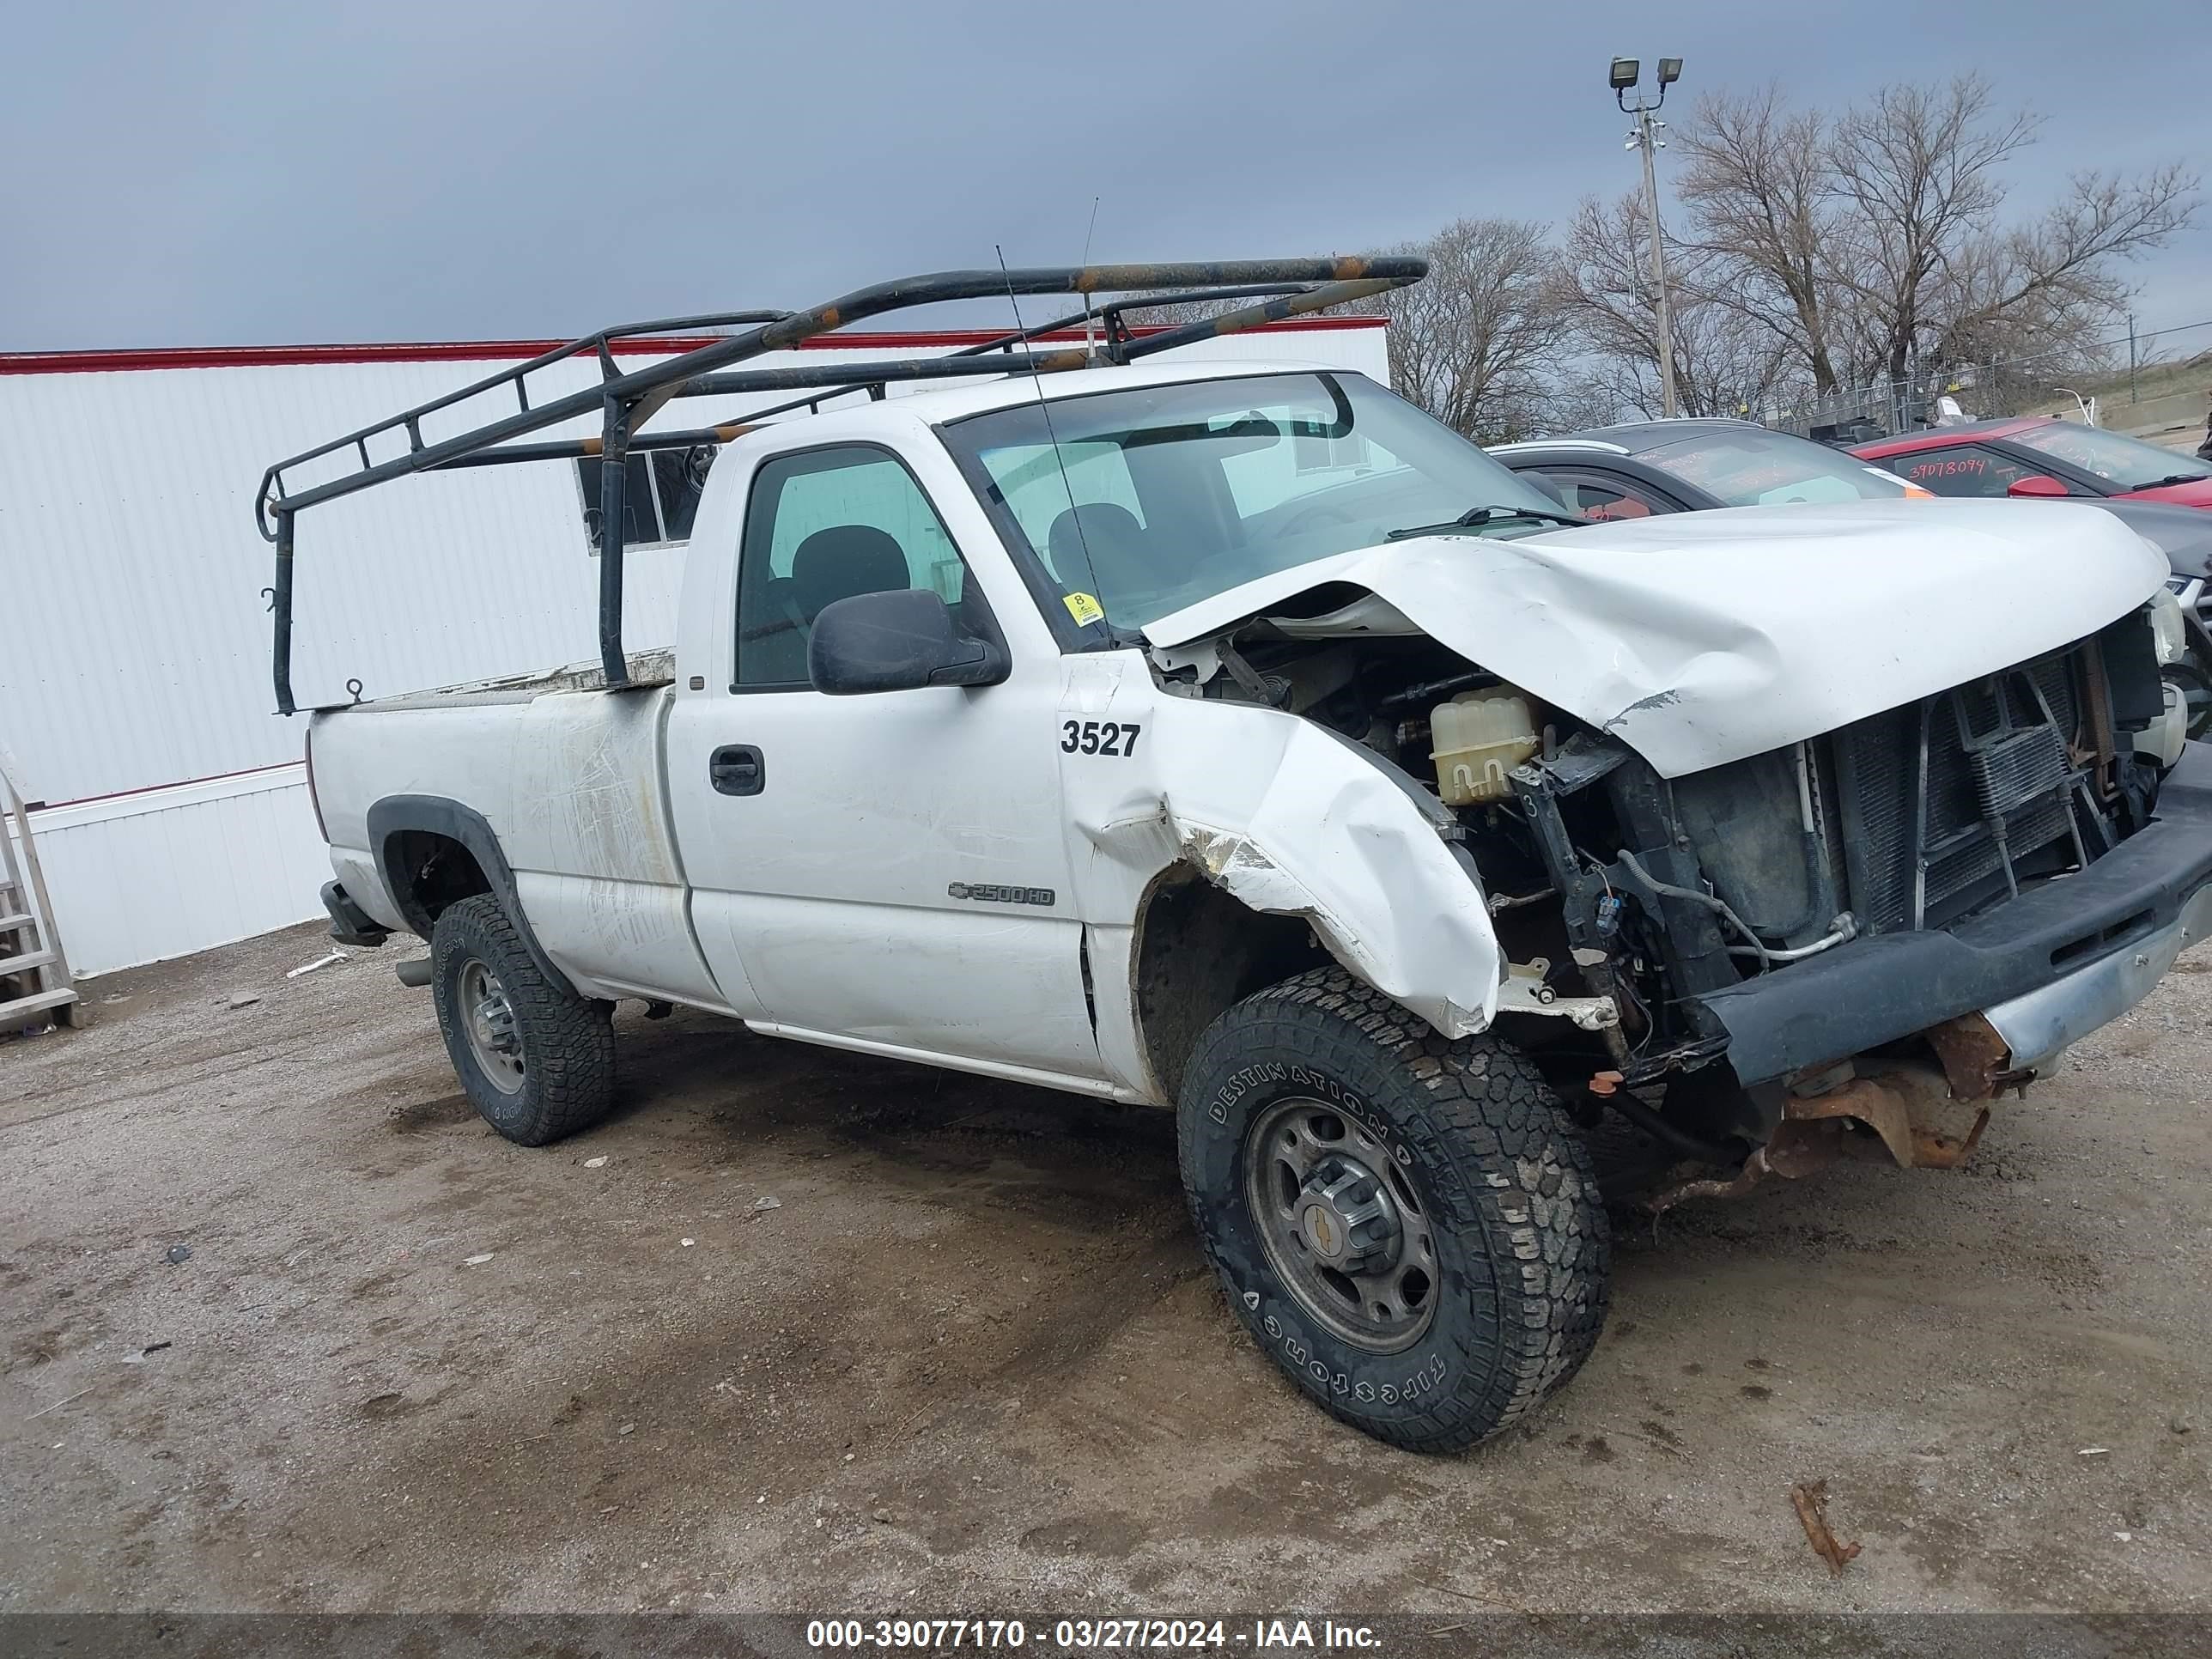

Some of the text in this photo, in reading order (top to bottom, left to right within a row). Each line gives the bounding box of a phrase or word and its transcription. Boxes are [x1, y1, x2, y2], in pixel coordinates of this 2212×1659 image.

[1909, 459, 1986, 479] 39078094
[1074, 595, 1085, 605] 8
[1060, 720, 1141, 757] 3527
[1523, 794, 1537, 817] 3
[1208, 1061, 1389, 1139] DESTINATION
